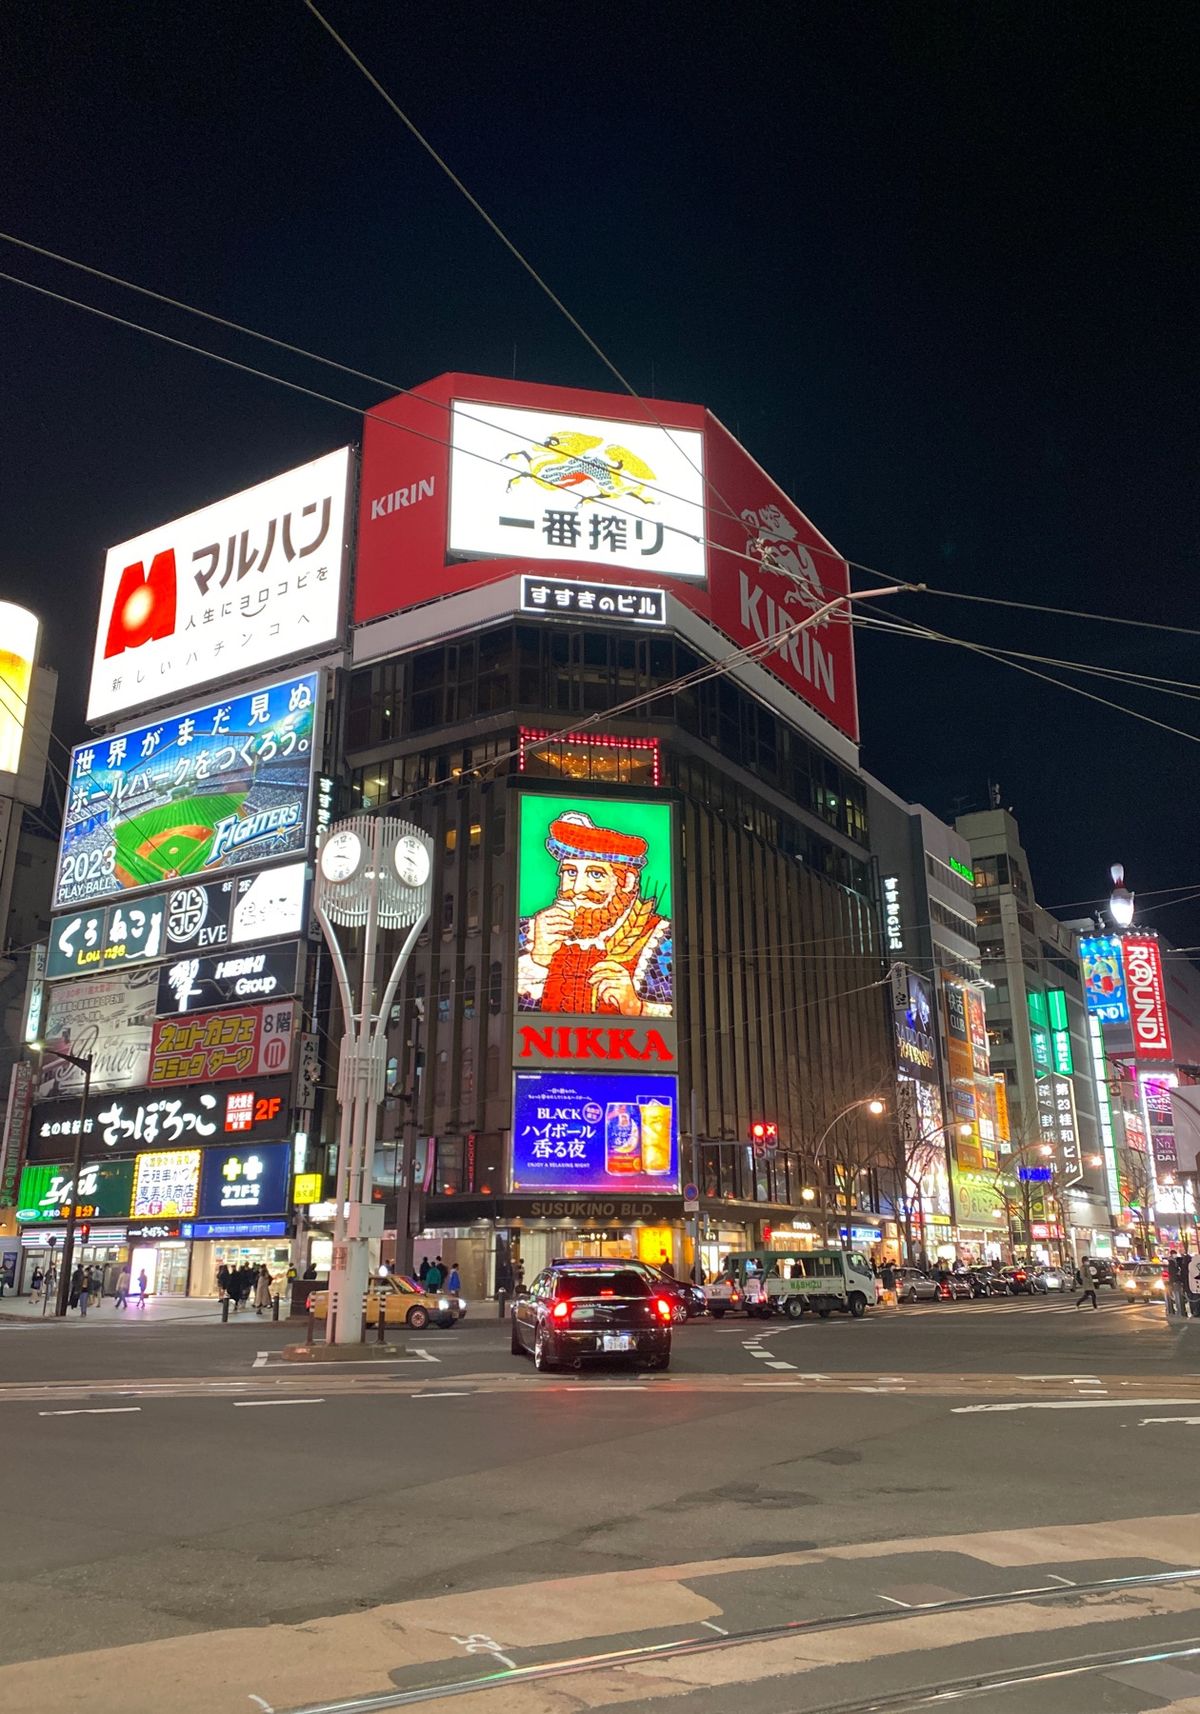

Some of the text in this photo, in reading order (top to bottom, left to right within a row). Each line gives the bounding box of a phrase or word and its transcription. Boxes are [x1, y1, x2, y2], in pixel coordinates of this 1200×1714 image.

[370, 475, 436, 520] KIRIN
[192, 496, 332, 597] マルハン
[498, 509, 665, 555] 一番搾り
[185, 566, 328, 631] 人生にヨロコビを
[530, 586, 657, 616] すすきのビル
[738, 569, 836, 704] KIRIN
[76, 683, 312, 780] 世界がまだ見ぬ
[70, 716, 309, 813] ボールパークをつくろう。
[204, 802, 301, 867] FIGHTERS
[60, 845, 116, 885] 2023
[58, 883, 84, 900] PLAY
[222, 881, 233, 892] 8F
[884, 877, 903, 950] すすきのビル
[58, 908, 146, 958] くろねこ
[198, 924, 228, 946] EVE
[235, 976, 277, 995] Group
[1127, 945, 1168, 1050] ROUND1
[156, 1016, 258, 1054] ネットカフェ
[263, 1011, 291, 1035] 8階
[517, 1024, 674, 1060] NIKKA
[151, 1047, 252, 1082] コミック ダーツ
[97, 1095, 217, 1147] さっぽろっこ
[255, 1097, 282, 1121] 2F
[537, 1107, 582, 1121] BLACK
[521, 1123, 596, 1140] ハイボール
[1055, 1083, 1077, 1174] 第23桂和ビル
[532, 1138, 587, 1159] 香る夜
[531, 1202, 657, 1216] SUSUKINO BLD.
[790, 1279, 823, 1290] WASHIZU
